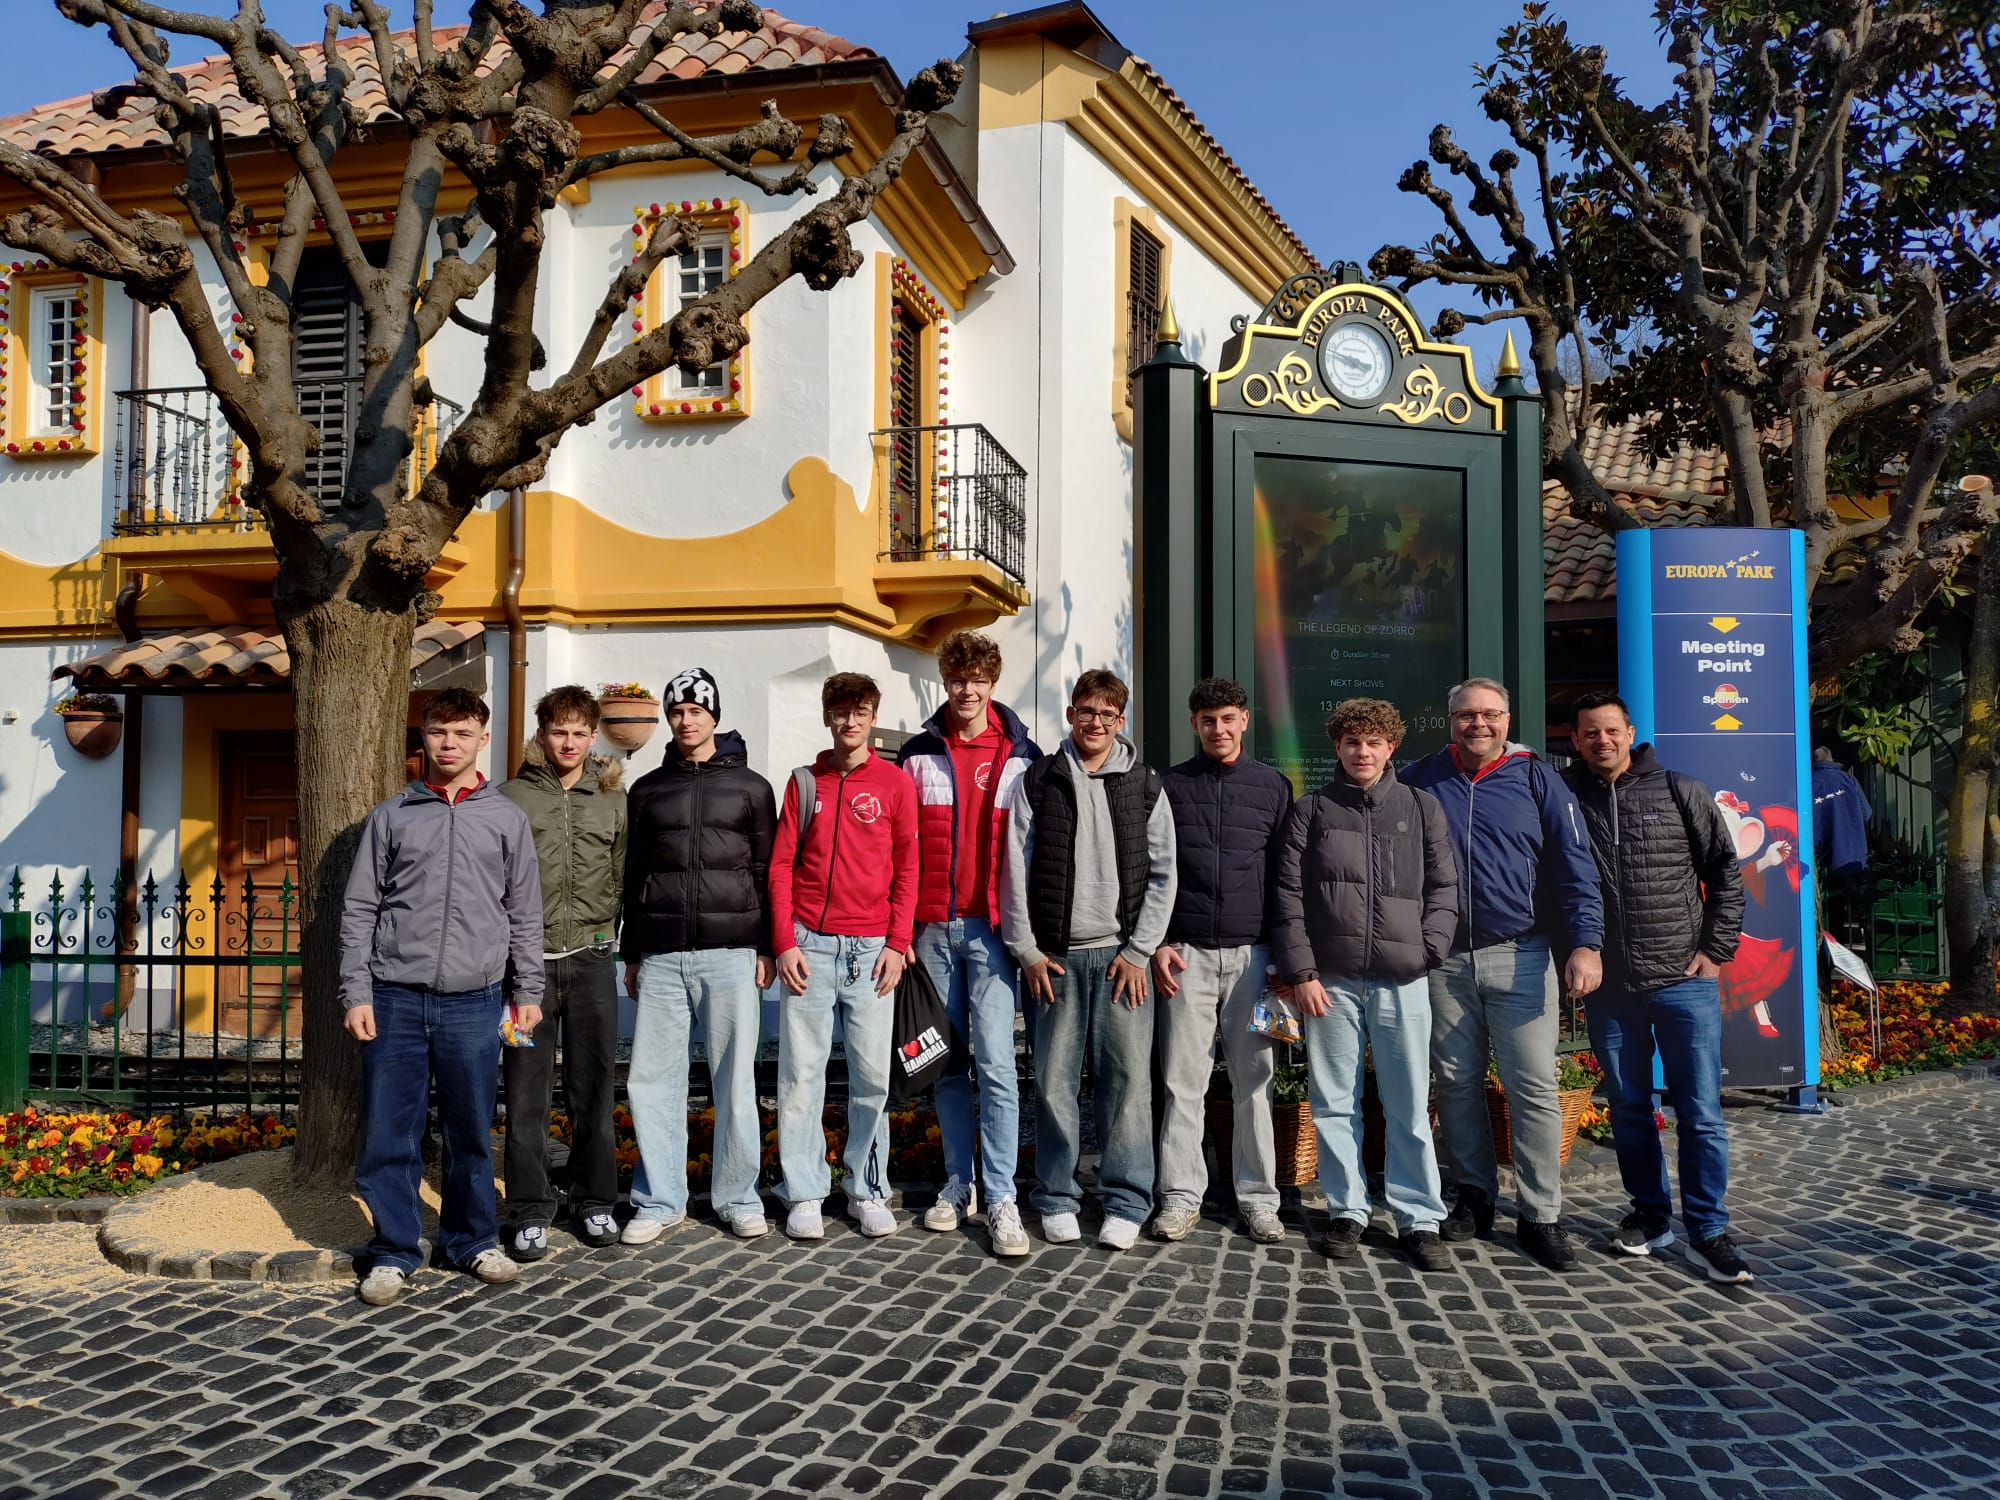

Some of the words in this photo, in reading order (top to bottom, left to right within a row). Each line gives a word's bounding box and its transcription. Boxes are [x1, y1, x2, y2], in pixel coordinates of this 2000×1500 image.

[1302, 296, 1368, 348] EUROPA
[1378, 305, 1415, 358] PARK
[1665, 565, 1727, 578] EUROPA
[1736, 565, 1773, 579] PARK
[1297, 621, 1318, 633] THE
[1320, 623, 1361, 634] LEGEND
[1363, 624, 1377, 634] OF
[1379, 625, 1416, 636] ZORRO
[1682, 640, 1765, 656] Meeting
[1698, 659, 1752, 673] Point
[1330, 679, 1353, 687] NEXT
[1354, 679, 1384, 688] SHOWS
[1320, 701, 1342, 712] 13:0
[1702, 695, 1749, 705] Spanien
[1413, 716, 1446, 729] 13:00
[897, 1047, 906, 1063] I
[903, 1039, 948, 1073] HANDBALL
